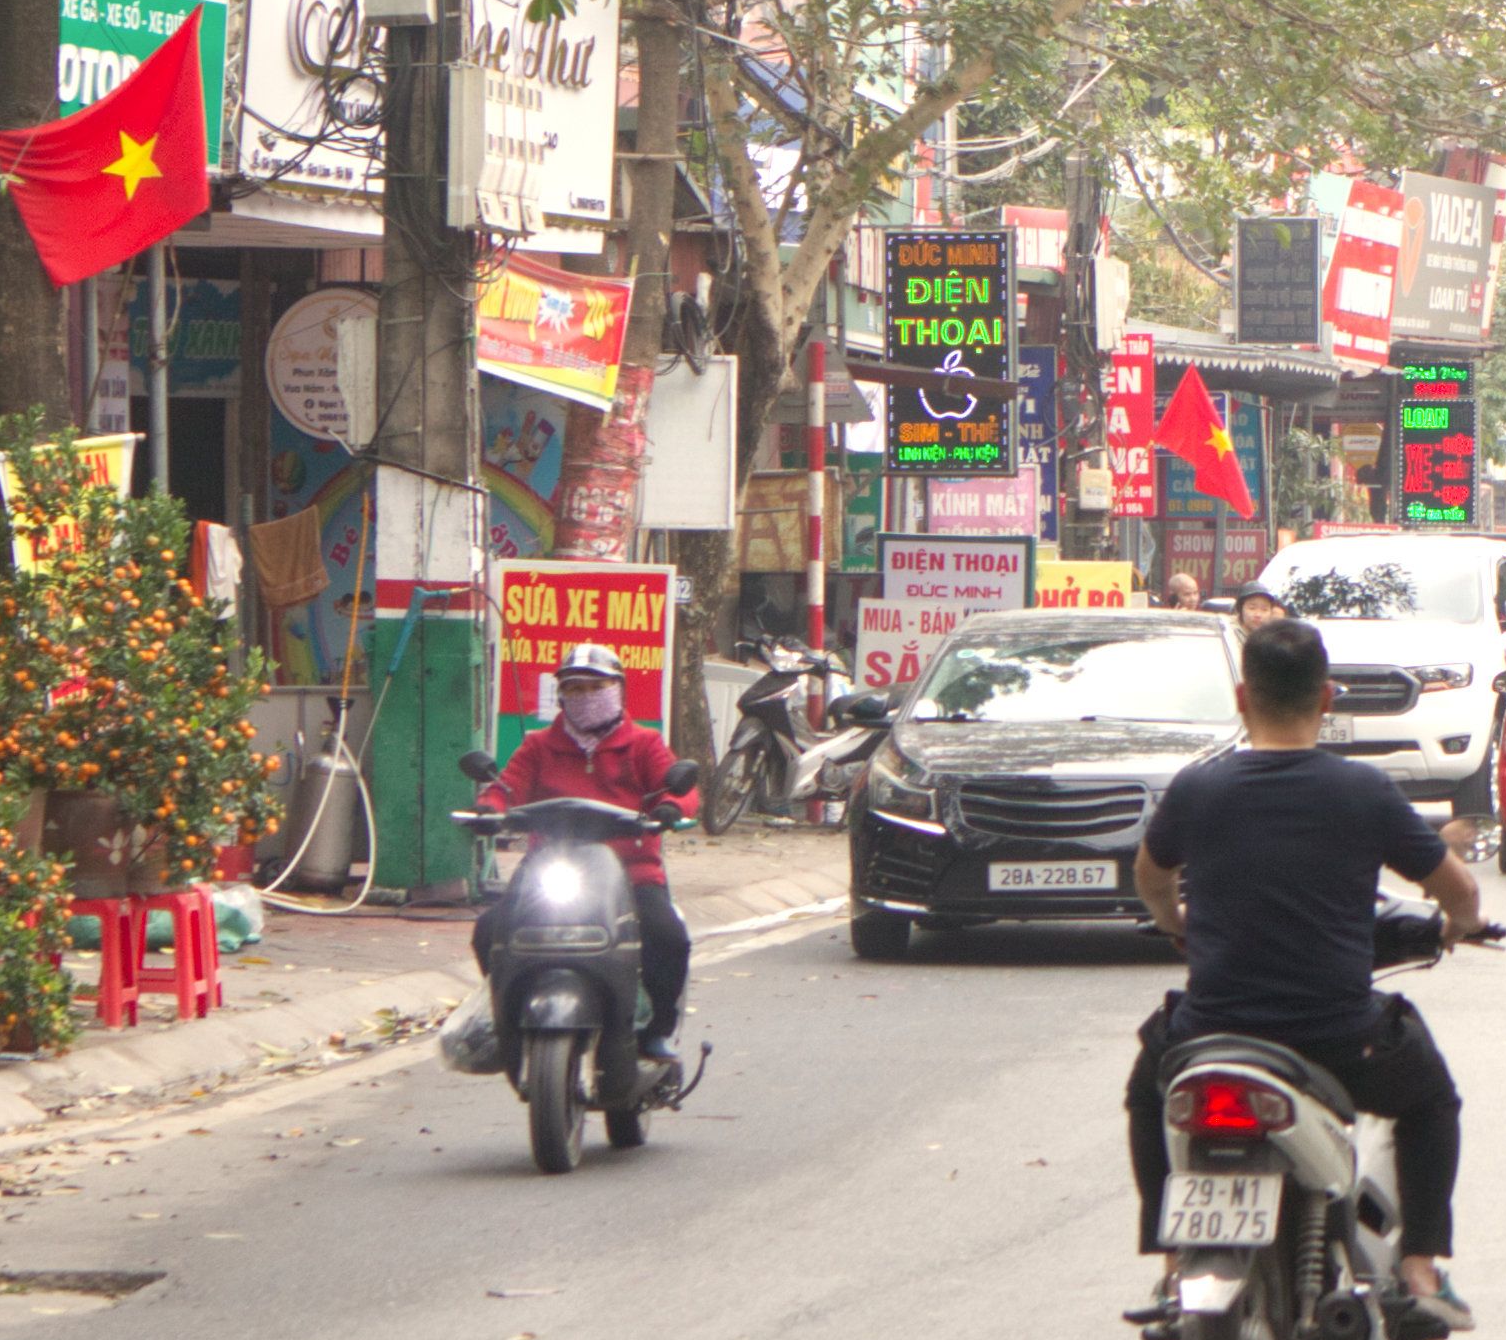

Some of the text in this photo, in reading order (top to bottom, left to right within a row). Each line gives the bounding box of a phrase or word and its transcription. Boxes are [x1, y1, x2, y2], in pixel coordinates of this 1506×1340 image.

[106, 1, 122, 25] XE
[123, 0, 141, 31] SỐ
[148, 10, 164, 34] XE
[1429, 191, 1484, 248] YADEA
[898, 240, 998, 267] ĐỨC MINH
[905, 270, 990, 312] ĐIỆN
[1428, 285, 1456, 311] LOAN
[894, 317, 1004, 355] THOẠI
[899, 414, 1000, 443] SIM THẺ
[1403, 407, 1449, 429] LOAN
[932, 489, 980, 517] KÍNH
[985, 487, 1030, 517] MẮT
[1173, 534, 1257, 553] SHOWOOM
[890, 548, 945, 575] ĐIỆN
[953, 552, 1019, 577] THOẠI
[505, 570, 666, 632] SỬA XE MÁY
[905, 582, 1002, 599] ĐỨC MINH
[863, 604, 957, 635] MUA BÁN
[536, 639, 558, 664] XE
[619, 644, 664, 675] CHẠM
[999, 866, 1107, 887] 28A-228.67
[1183, 1178, 1262, 1209] 29-N1
[1169, 1210, 1268, 1242] 780.75
